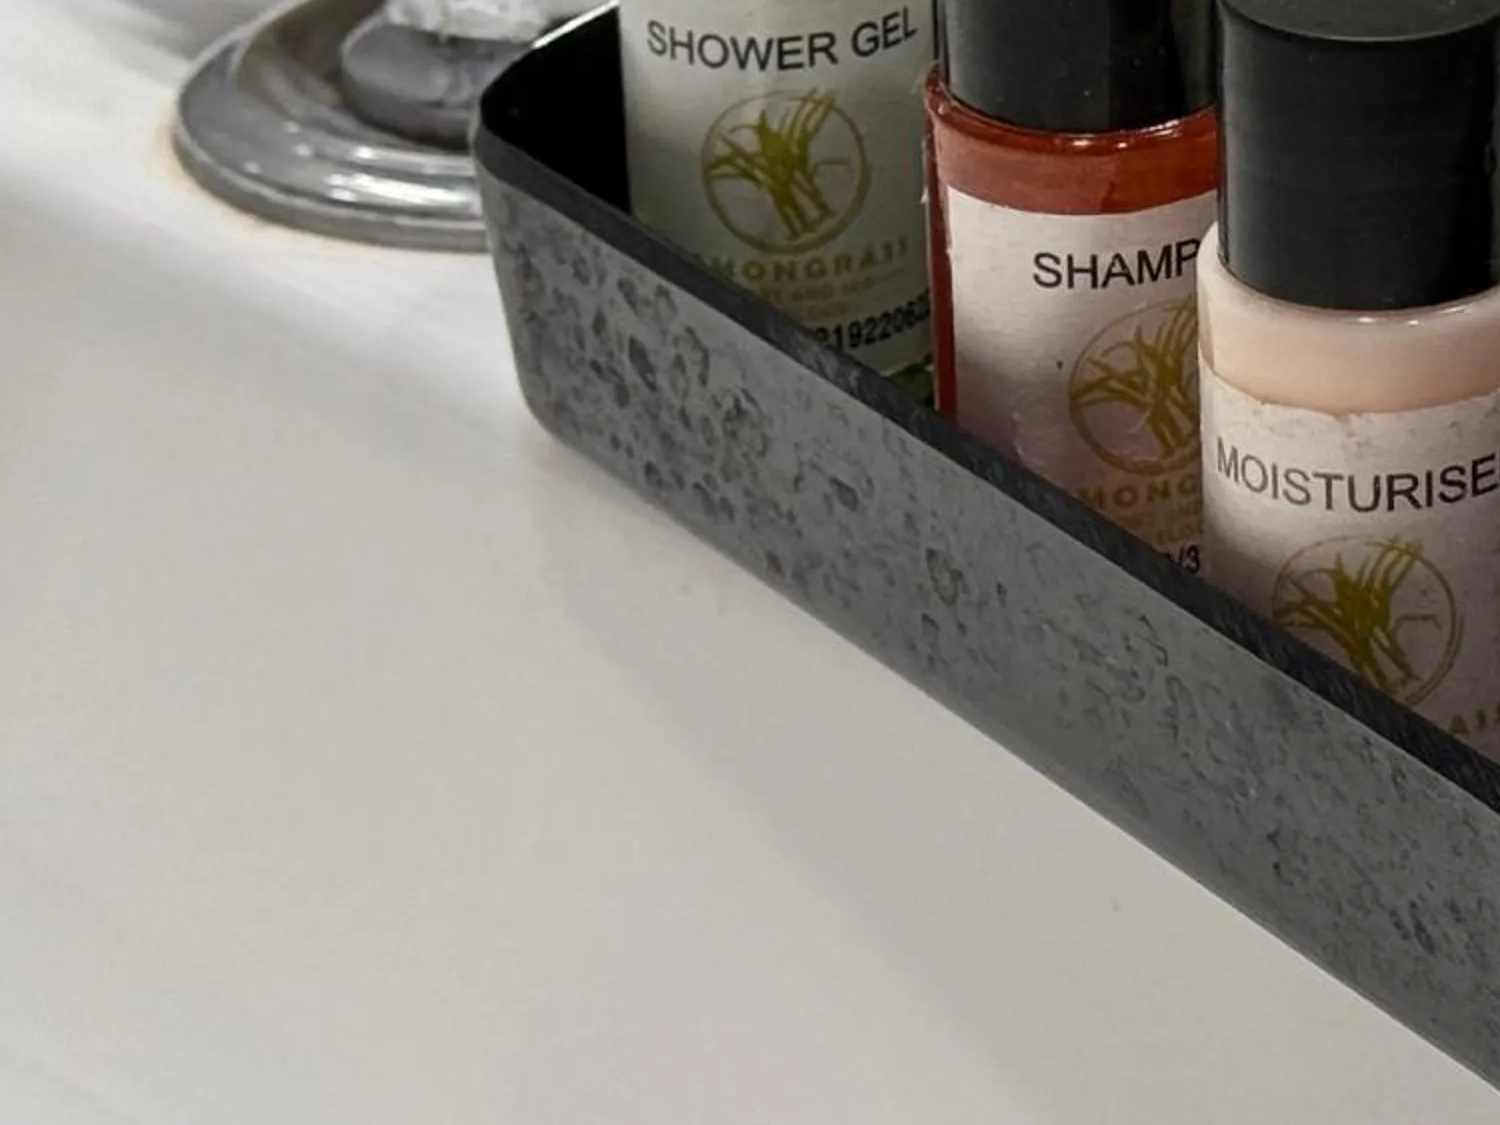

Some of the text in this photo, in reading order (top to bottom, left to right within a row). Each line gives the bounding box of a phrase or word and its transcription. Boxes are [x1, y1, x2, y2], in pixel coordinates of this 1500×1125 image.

[647, 7, 918, 72] SHOWER GEL
[1032, 238, 1199, 289] SHAMP
